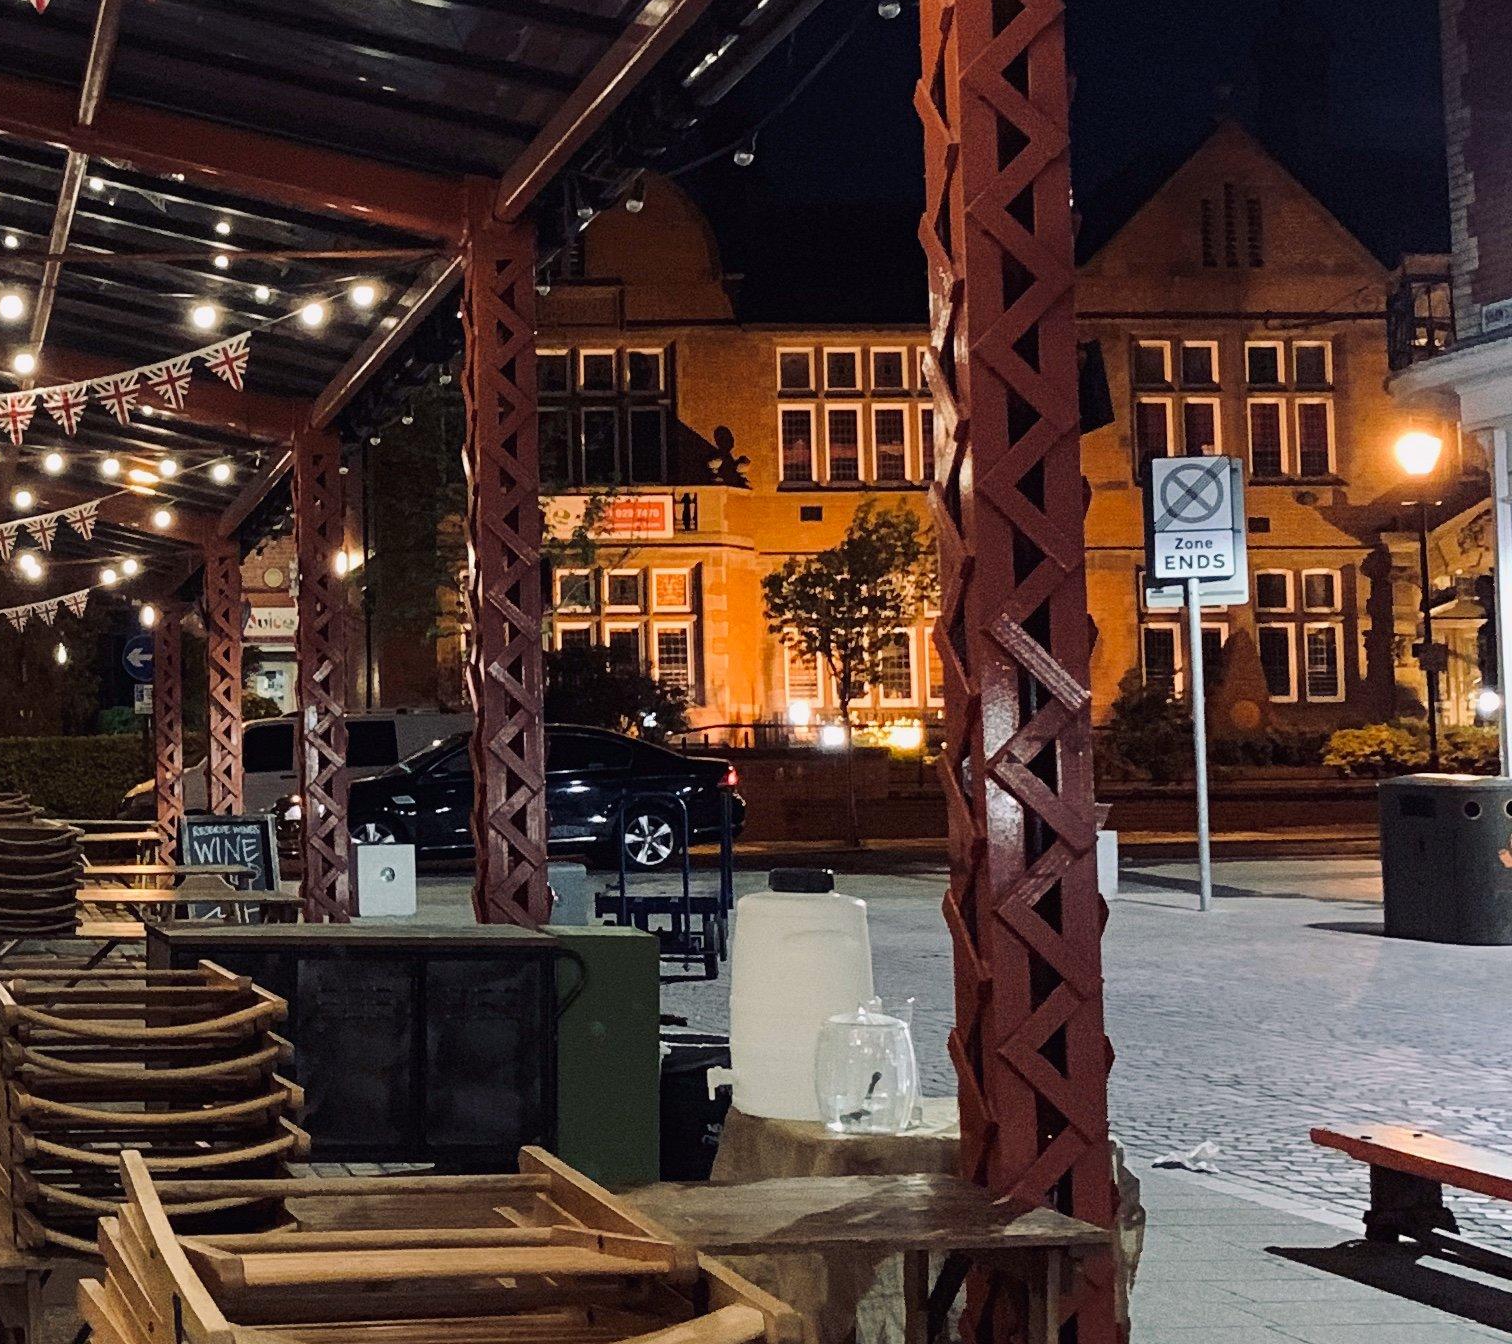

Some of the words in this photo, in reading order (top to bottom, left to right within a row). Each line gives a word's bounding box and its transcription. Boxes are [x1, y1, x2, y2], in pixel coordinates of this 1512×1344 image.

[1174, 537, 1213, 550] Zone
[1164, 553, 1225, 570] ENDS
[193, 834, 260, 866] WINE
